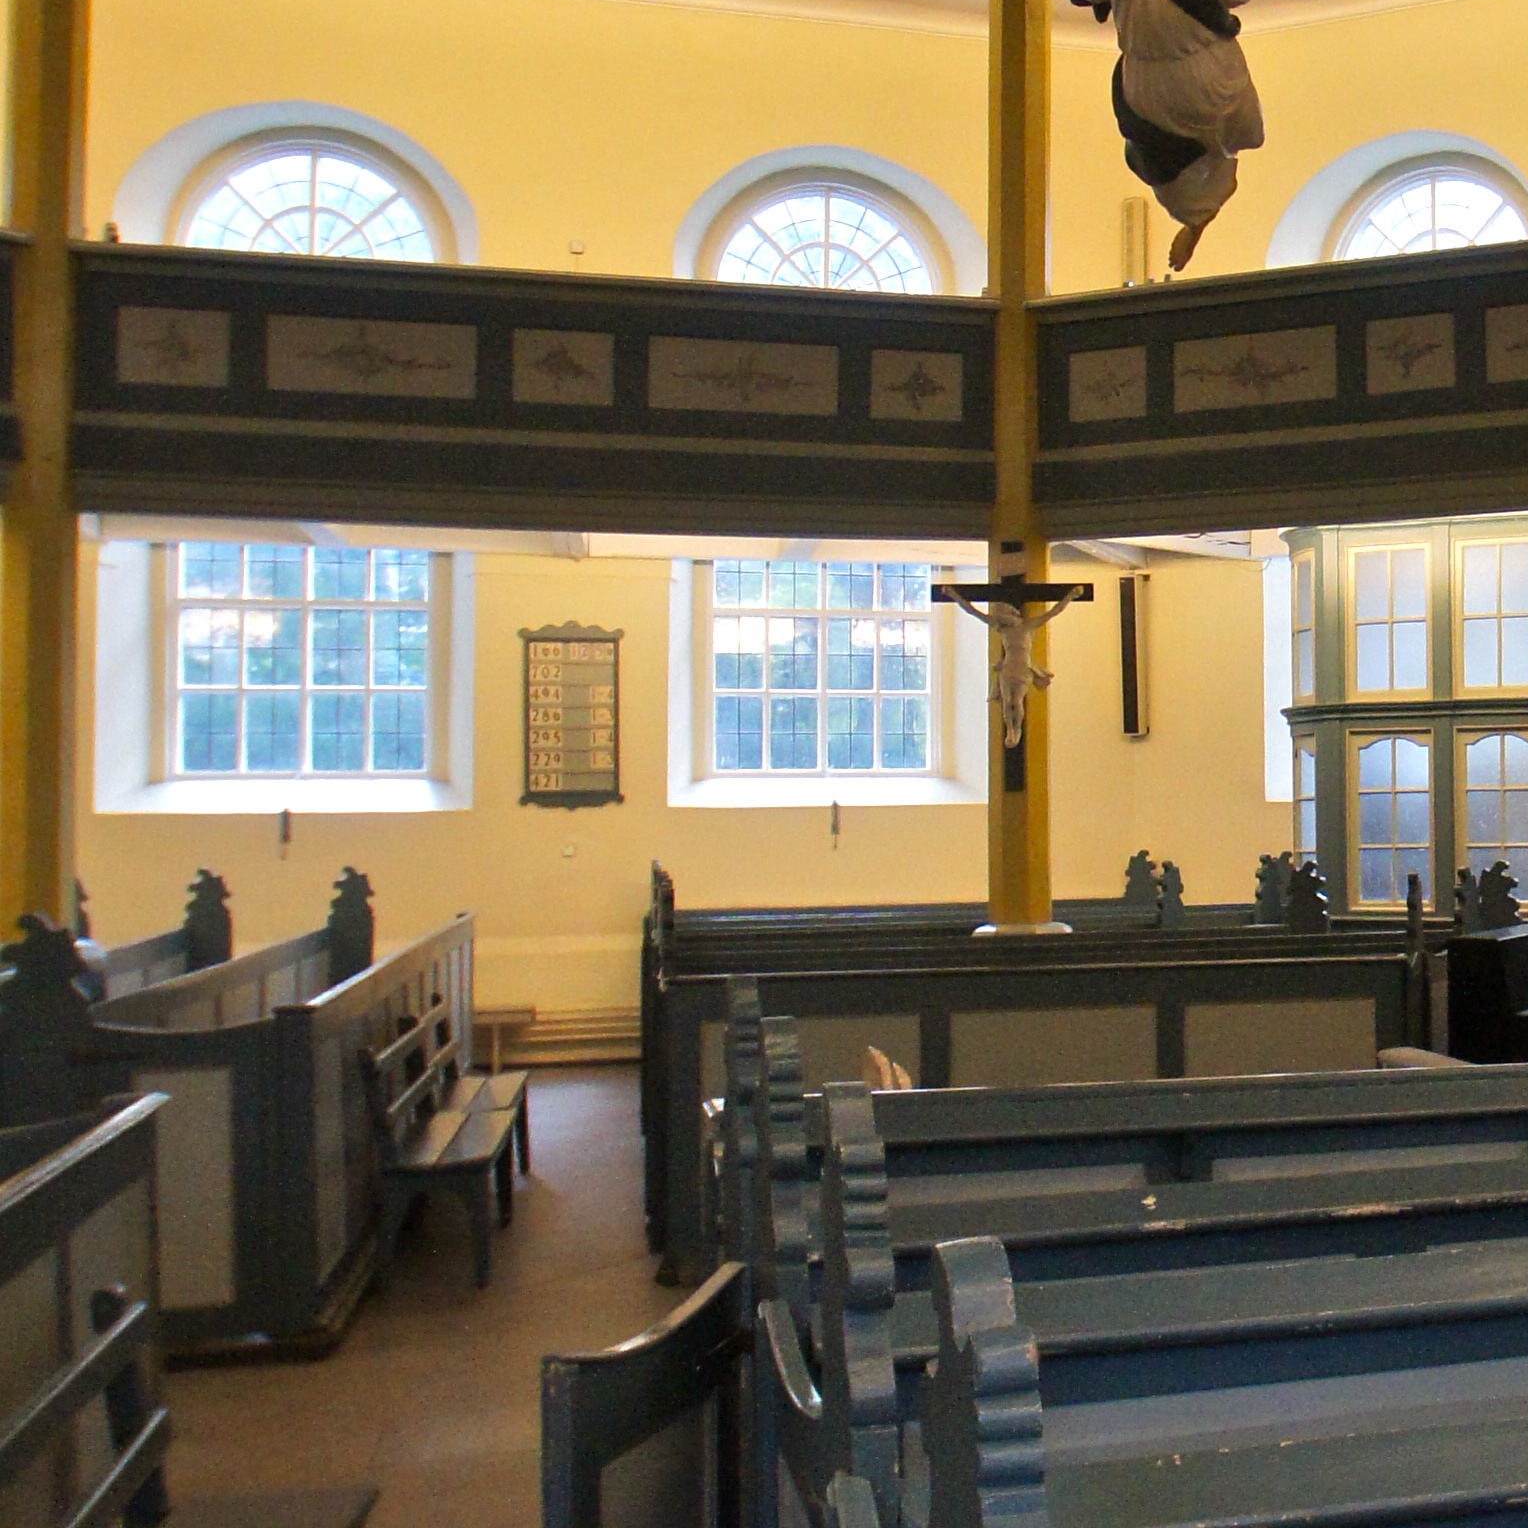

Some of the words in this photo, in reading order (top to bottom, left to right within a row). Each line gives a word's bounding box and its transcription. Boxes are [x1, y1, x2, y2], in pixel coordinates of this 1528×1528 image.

[532, 666, 561, 678] 702
[531, 731, 561, 744] 295
[531, 753, 561, 766] 229
